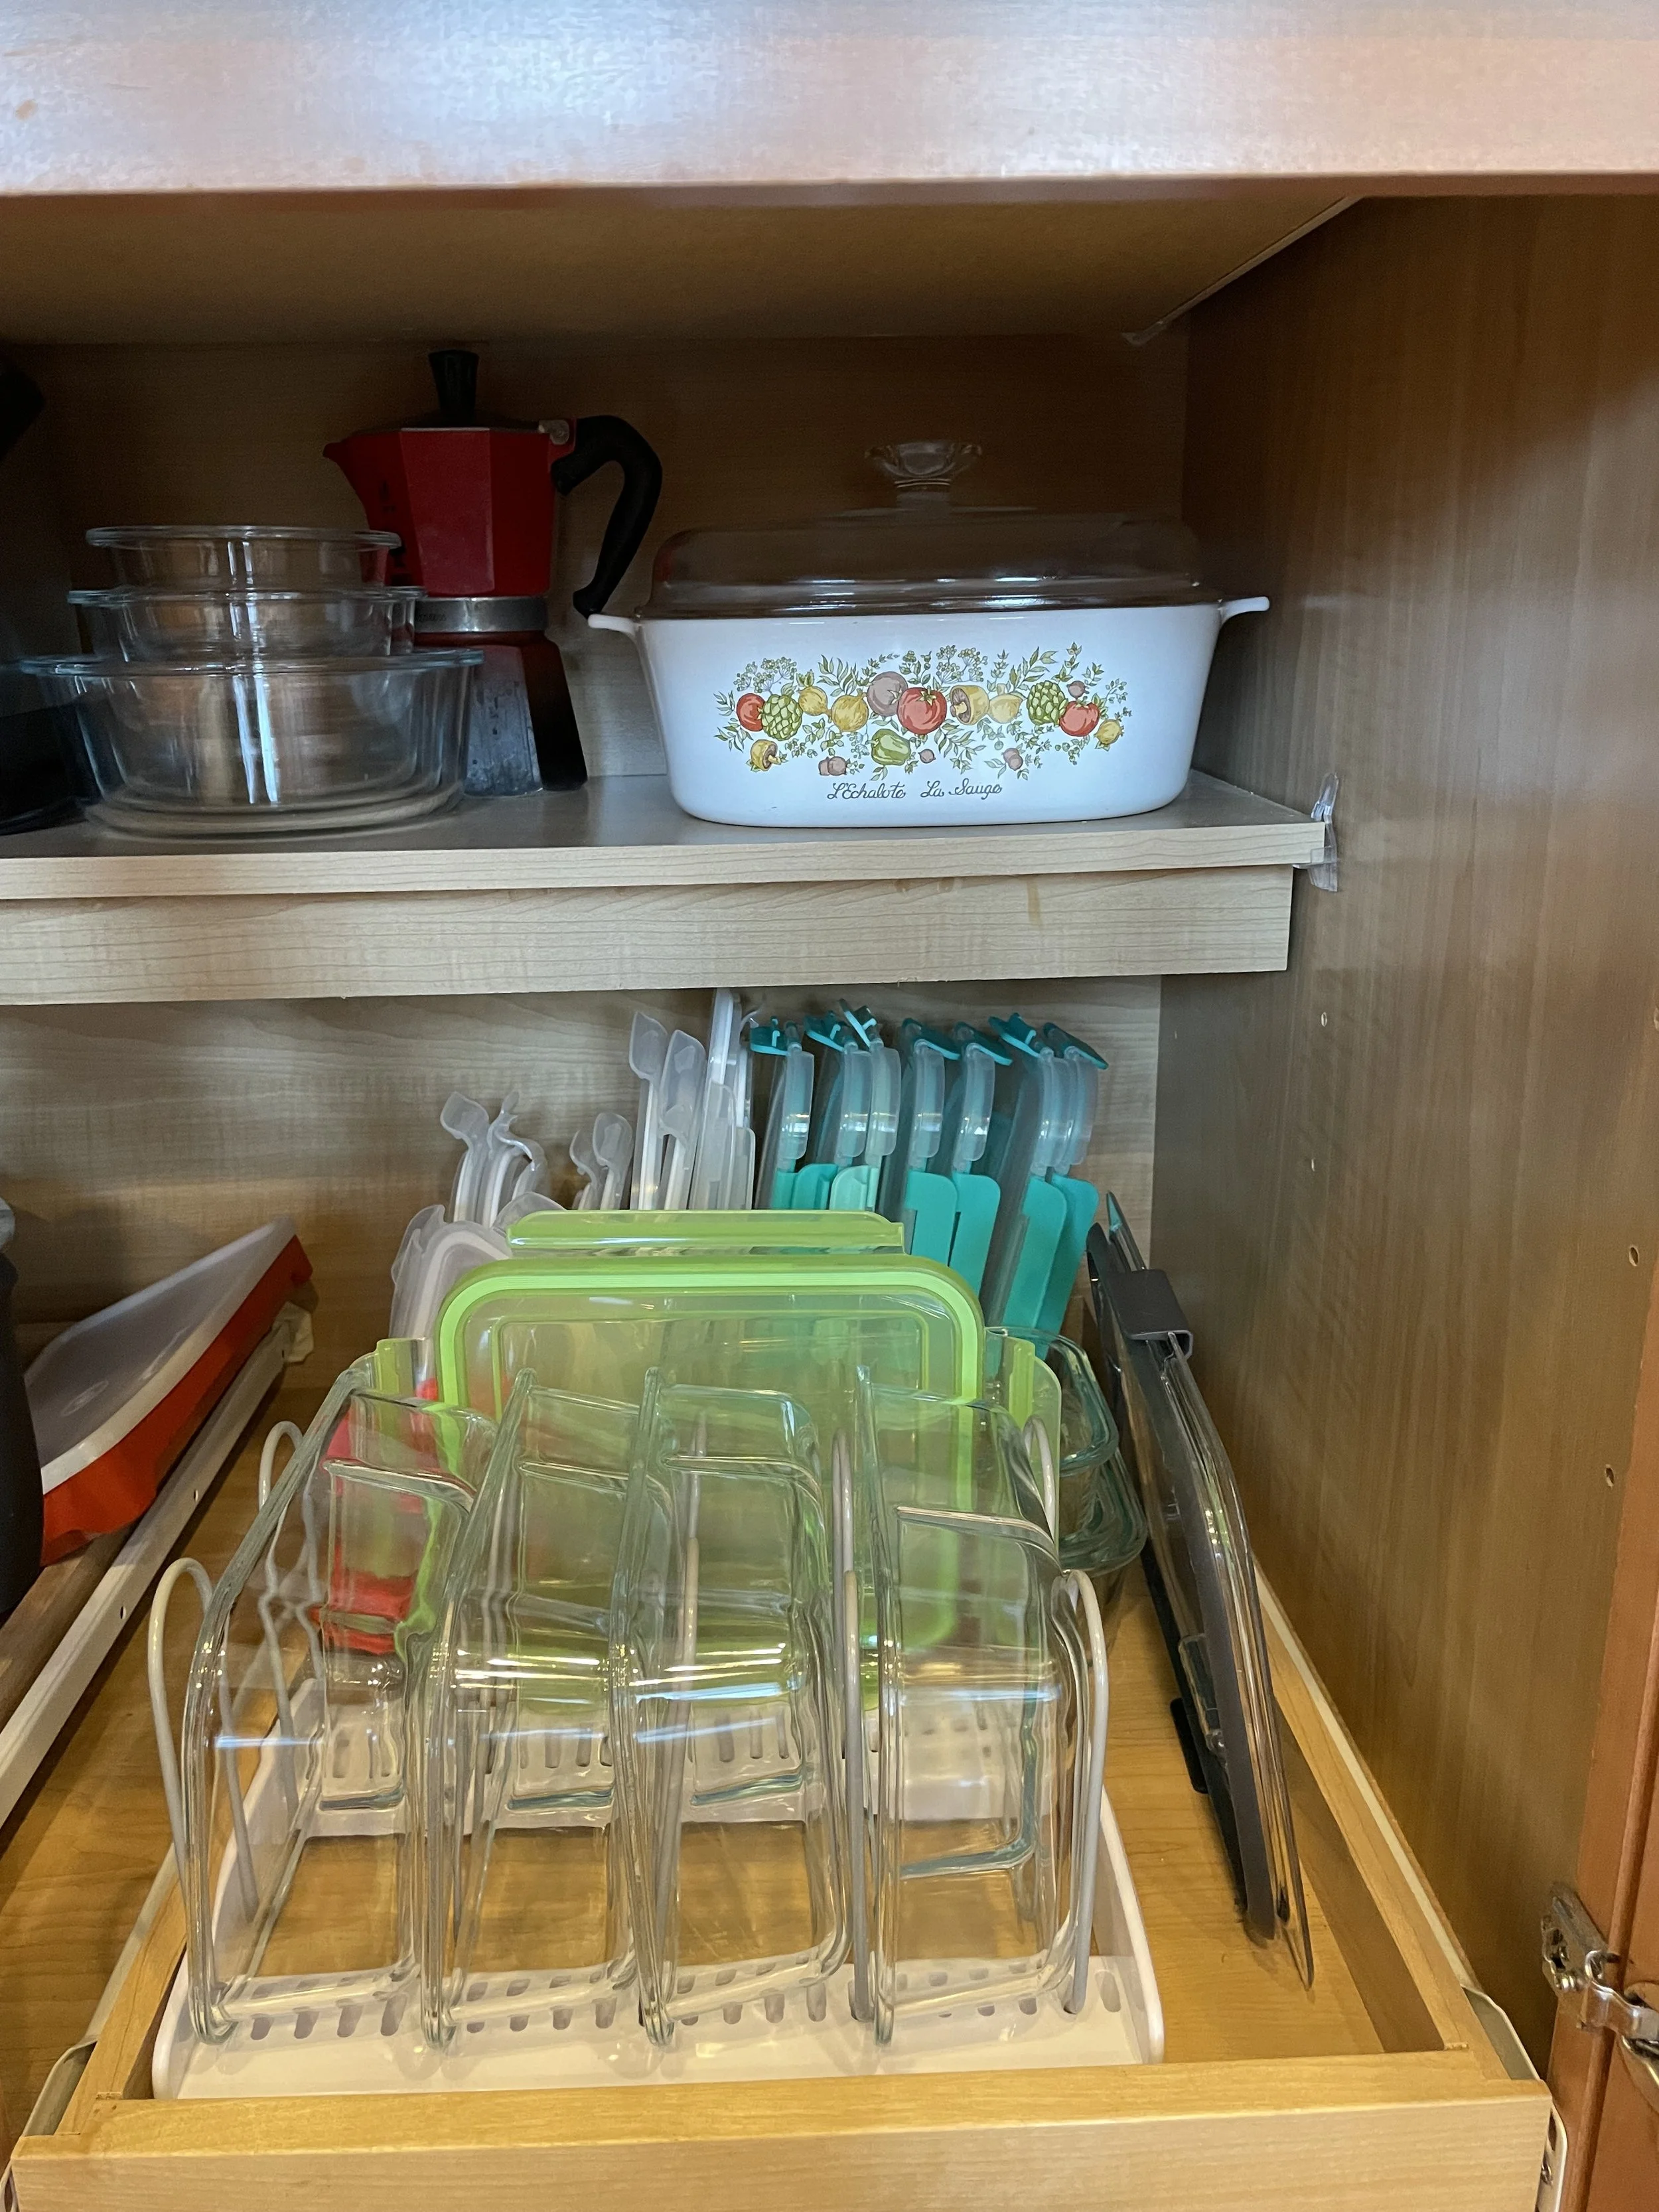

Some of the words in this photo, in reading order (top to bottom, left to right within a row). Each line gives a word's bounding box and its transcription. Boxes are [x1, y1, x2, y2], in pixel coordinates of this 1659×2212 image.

[828, 781, 906, 799] L'Echalote
[920, 780, 944, 798] La
[948, 778, 1003, 800] Sauge
